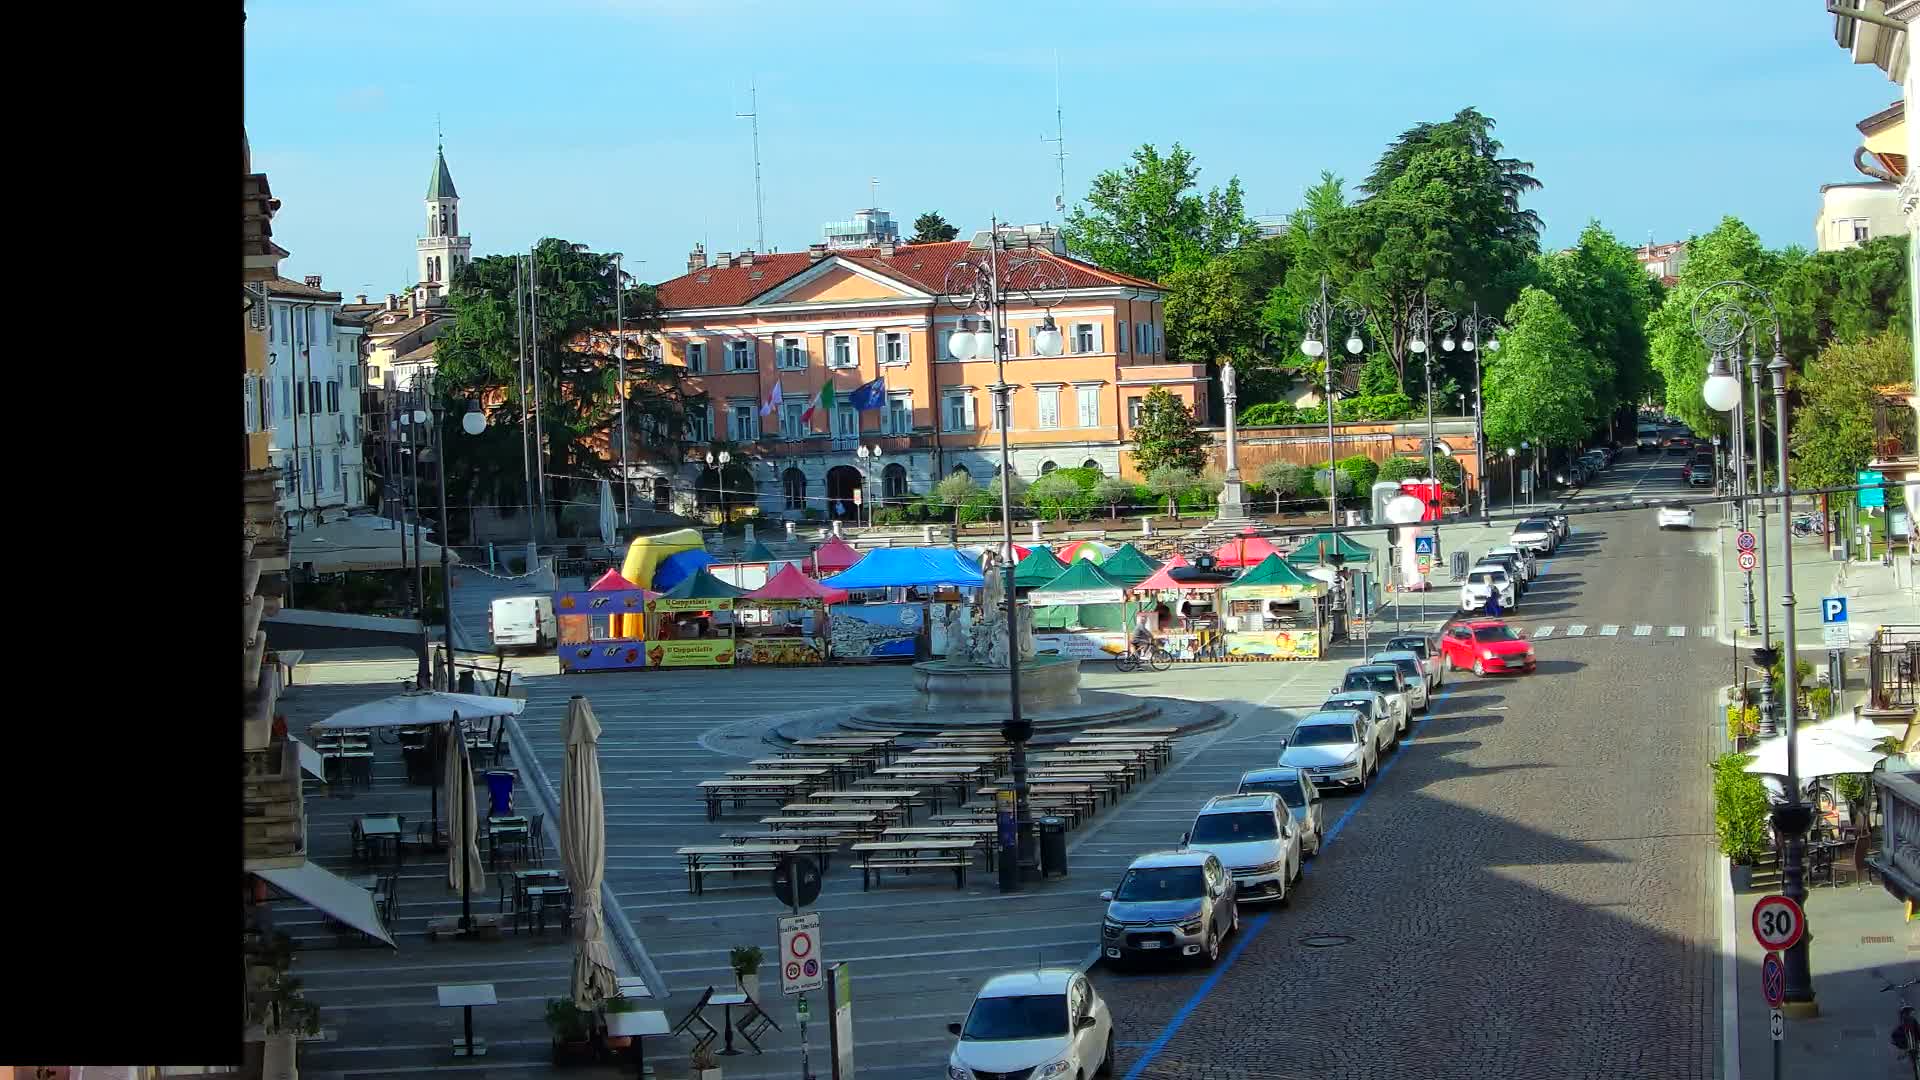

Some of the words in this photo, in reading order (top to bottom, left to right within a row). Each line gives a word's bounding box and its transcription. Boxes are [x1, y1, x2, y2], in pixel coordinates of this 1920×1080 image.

[1742, 556, 1753, 566] 20
[1827, 600, 1842, 620] P
[1762, 910, 1792, 936] 30
[789, 966, 797, 976] 20
